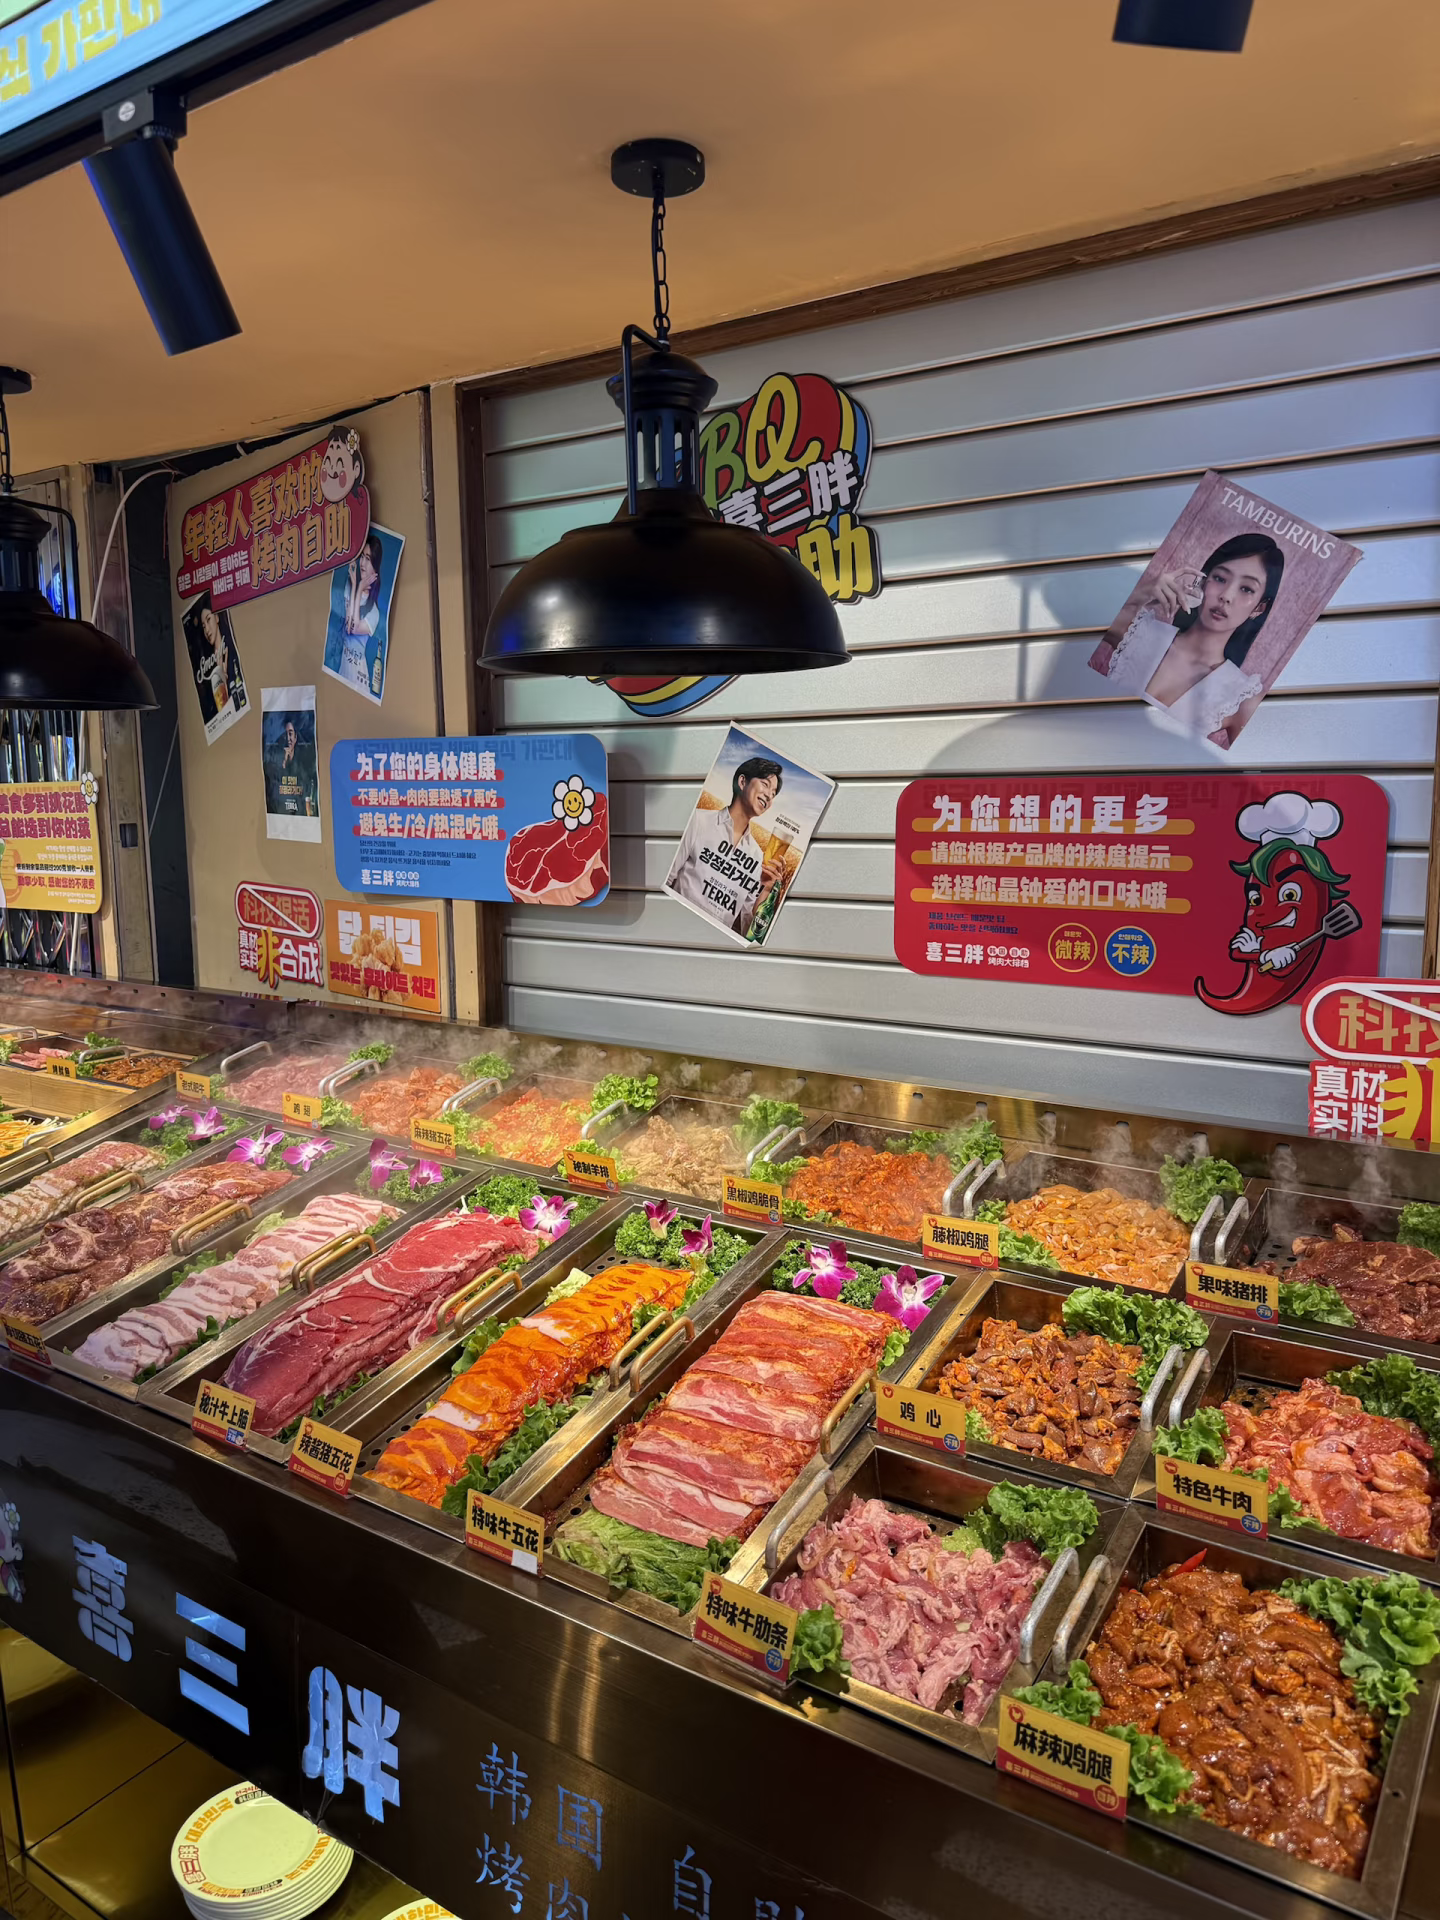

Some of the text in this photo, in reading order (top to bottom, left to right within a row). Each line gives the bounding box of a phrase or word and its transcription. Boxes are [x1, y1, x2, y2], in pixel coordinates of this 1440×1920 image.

[184, 449, 325, 563] 年轻人喜欢的
[1220, 487, 1336, 560] TAMBURINS
[250, 500, 351, 589] 烤肉自助
[357, 750, 497, 781] 为了您的身体健康
[932, 793, 1169, 834] 为您想的更多
[699, 847, 765, 898] 청정라거다!
[718, 840, 759, 874] 이 맛이
[930, 841, 1171, 869] 请您根据产品牌的辣度提示
[701, 879, 738, 916] TERRA
[931, 874, 1168, 910] 选择您最钟爱的口味哦
[257, 927, 320, 989] 非合成
[925, 941, 984, 965] 喜三胖
[1055, 938, 1091, 961] 微辣
[1111, 942, 1150, 965] 不辣
[411, 975, 436, 1000] 치킨
[1313, 1065, 1388, 1103] 真材
[1313, 1099, 1385, 1136] 实料
[727, 1186, 779, 1210] 黑椒鸡脆骨
[932, 1226, 989, 1251] 藤椒鸡腿
[1198, 1275, 1268, 1304] 果味猪排
[900, 1402, 941, 1428] 鸡心
[1173, 1474, 1251, 1513] 特色牛肉
[471, 1505, 539, 1553] 特味牛五花
[706, 1591, 789, 1651] 特味牛肋条
[1013, 1722, 1113, 1785] 麻辣鸡腿
[184, 1797, 235, 1843] 대한민국
